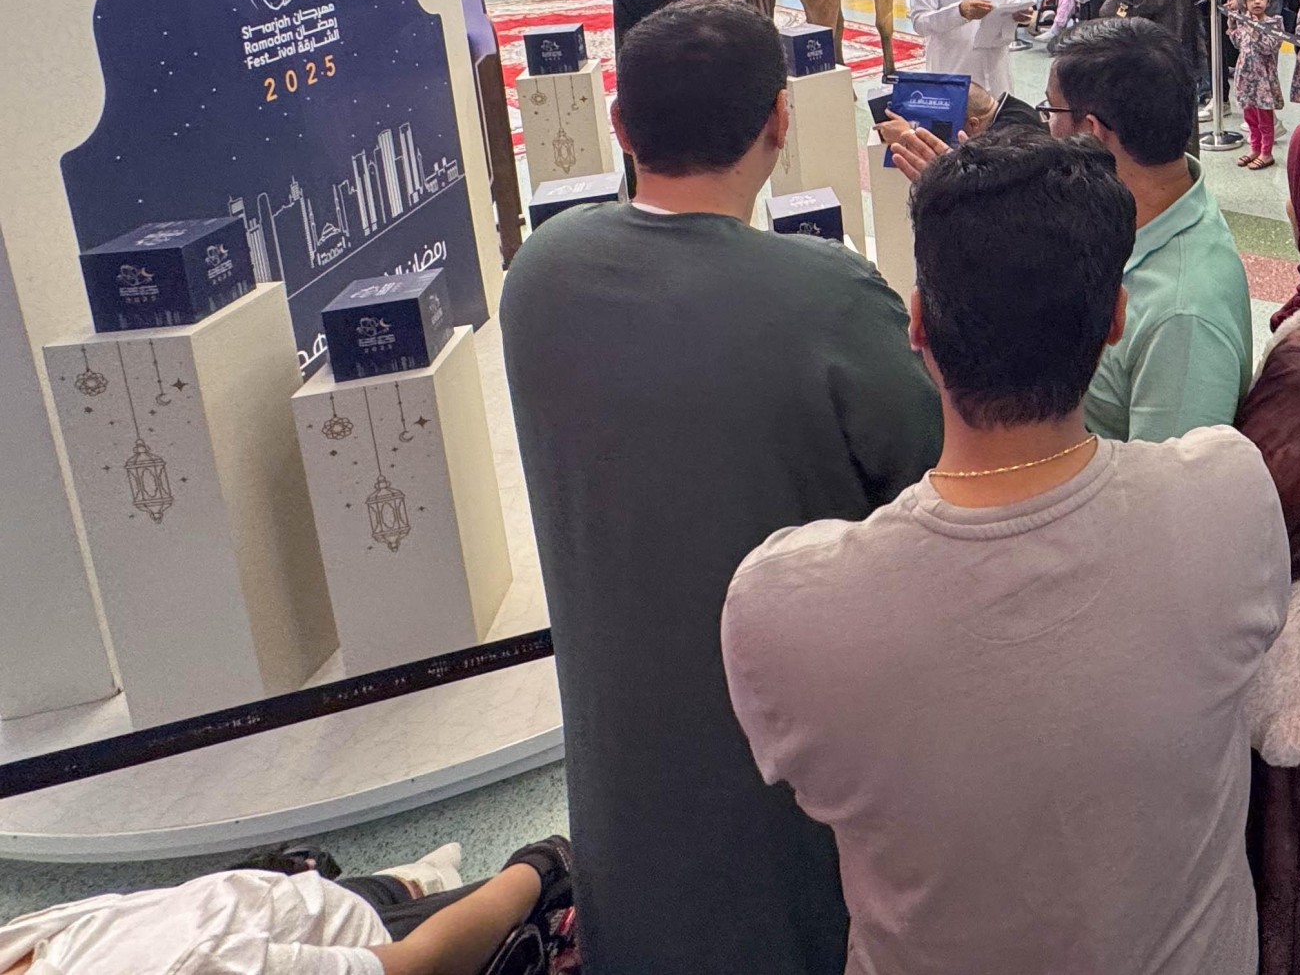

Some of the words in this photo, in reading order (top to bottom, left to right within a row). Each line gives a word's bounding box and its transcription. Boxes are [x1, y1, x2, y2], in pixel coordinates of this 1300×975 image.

[293, 3, 335, 24] مهرجان
[241, 14, 291, 39] Sharjah
[296, 17, 338, 40] رمضان
[244, 31, 294, 55] Ramadan
[298, 29, 340, 53] الشارقة
[247, 42, 296, 69] Festival
[264, 54, 336, 102] 2025
